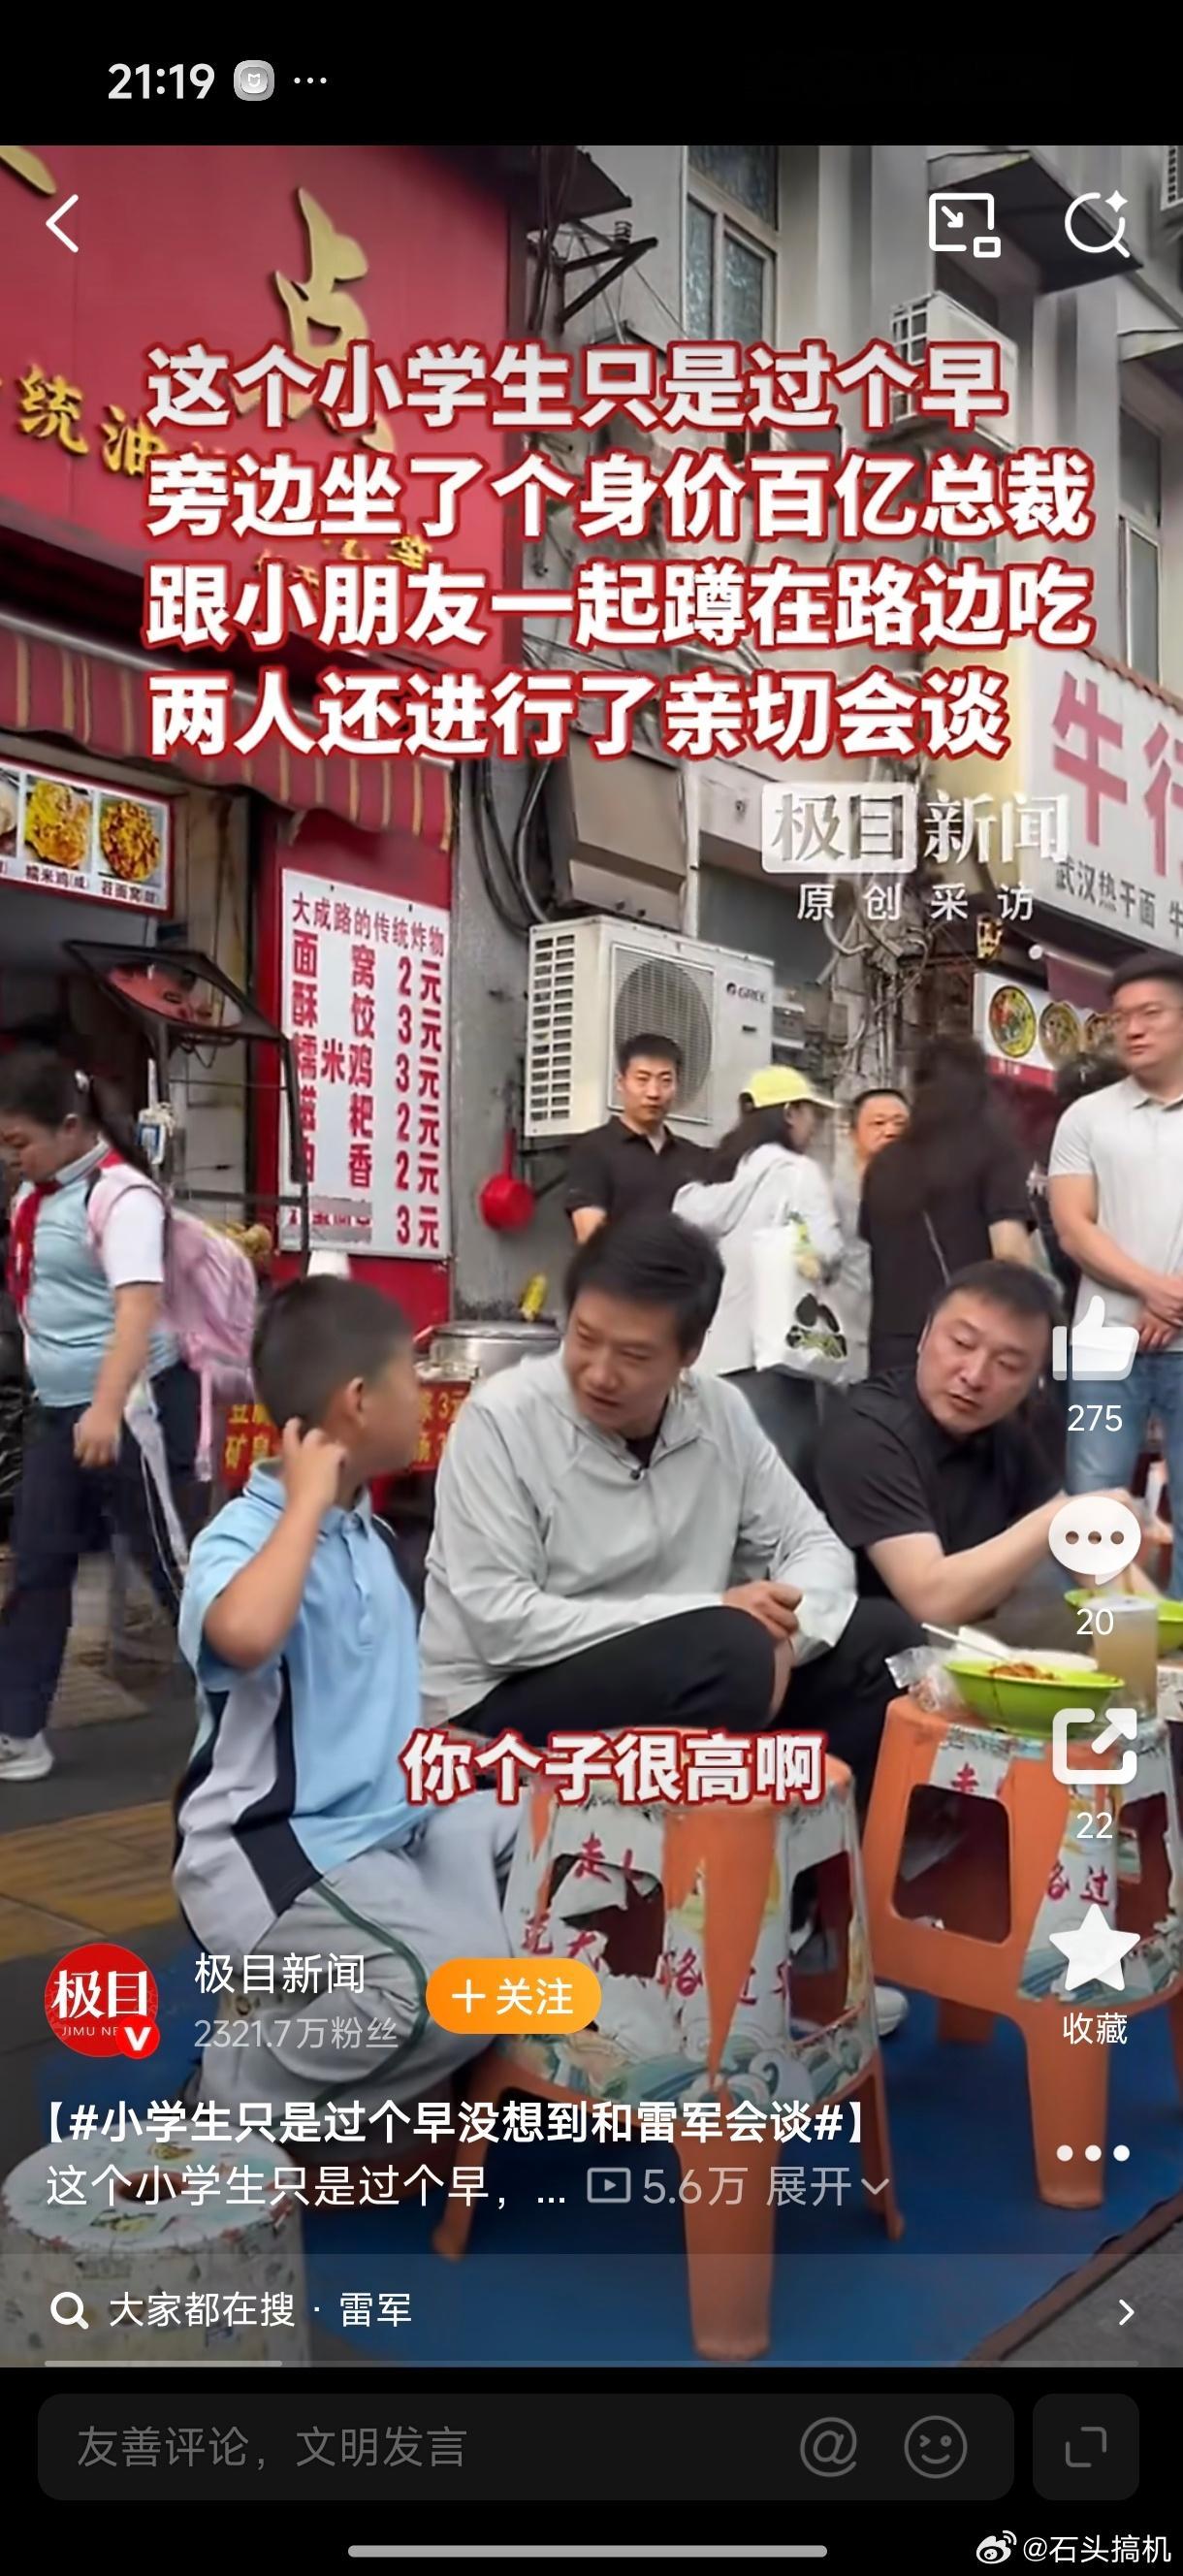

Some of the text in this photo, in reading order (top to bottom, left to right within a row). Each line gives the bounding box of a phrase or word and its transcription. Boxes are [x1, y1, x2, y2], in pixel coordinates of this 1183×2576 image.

[292, 891, 445, 958] 大成路的传统炸物
